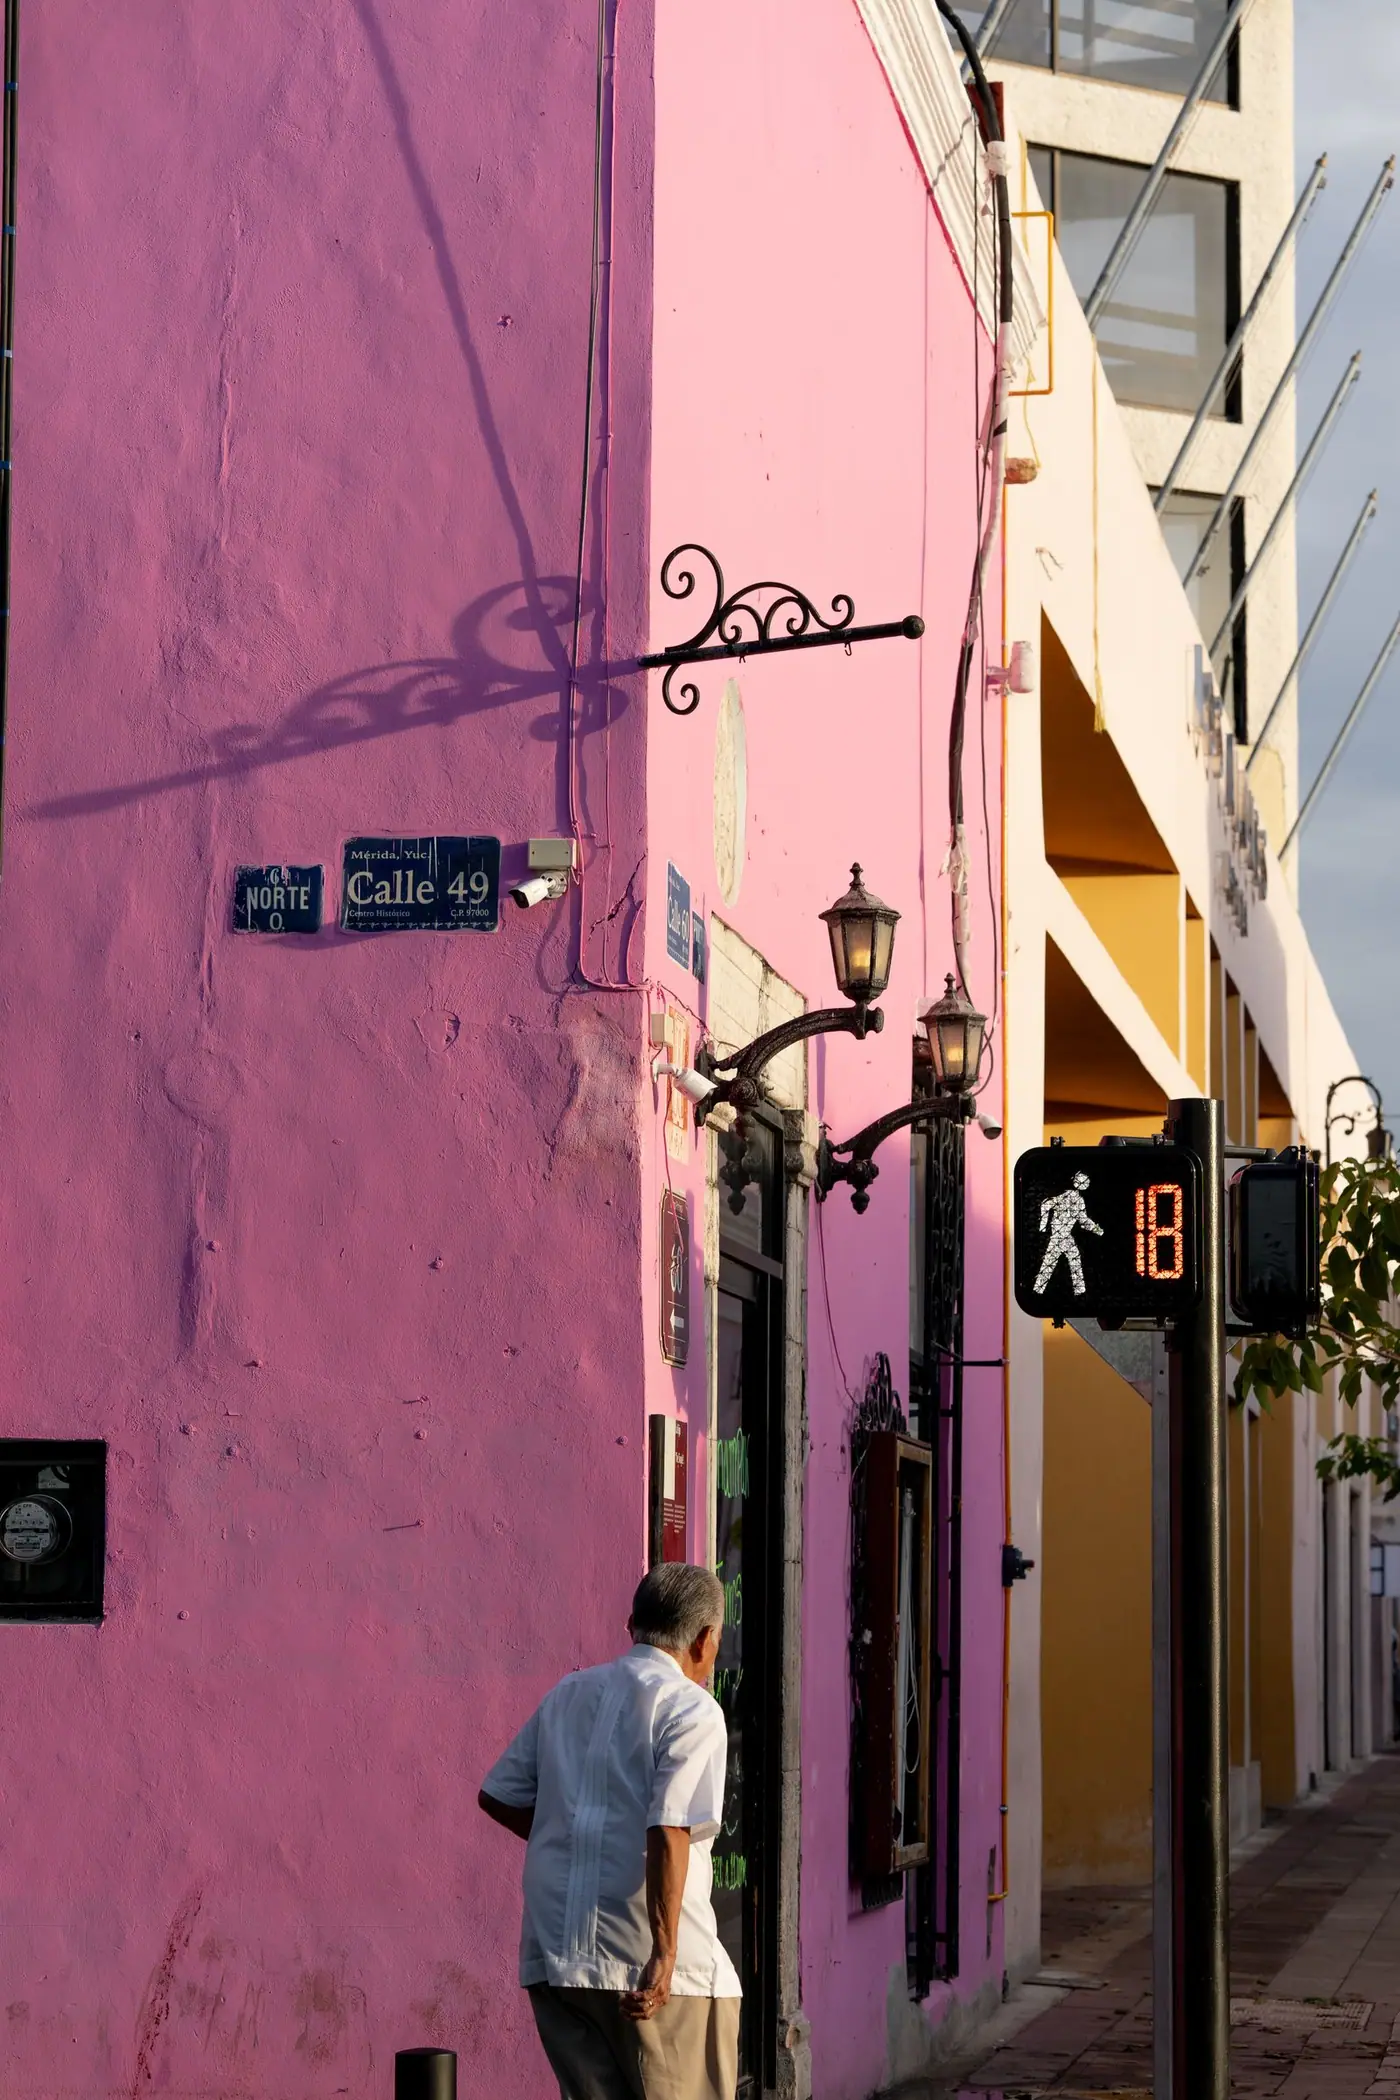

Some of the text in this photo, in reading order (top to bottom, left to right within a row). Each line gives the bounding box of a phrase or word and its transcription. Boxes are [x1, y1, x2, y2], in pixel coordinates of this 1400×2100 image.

[351, 850, 430, 860] Mérida, Yuc.
[247, 886, 310, 910] NORTE
[347, 869, 489, 904] Calle 49
[349, 909, 410, 917] Centro Histórico
[450, 909, 490, 917] C.P. 97000
[667, 896, 681, 937] Calle
[682, 909, 690, 943] 60
[1135, 1184, 1183, 1280] 18
